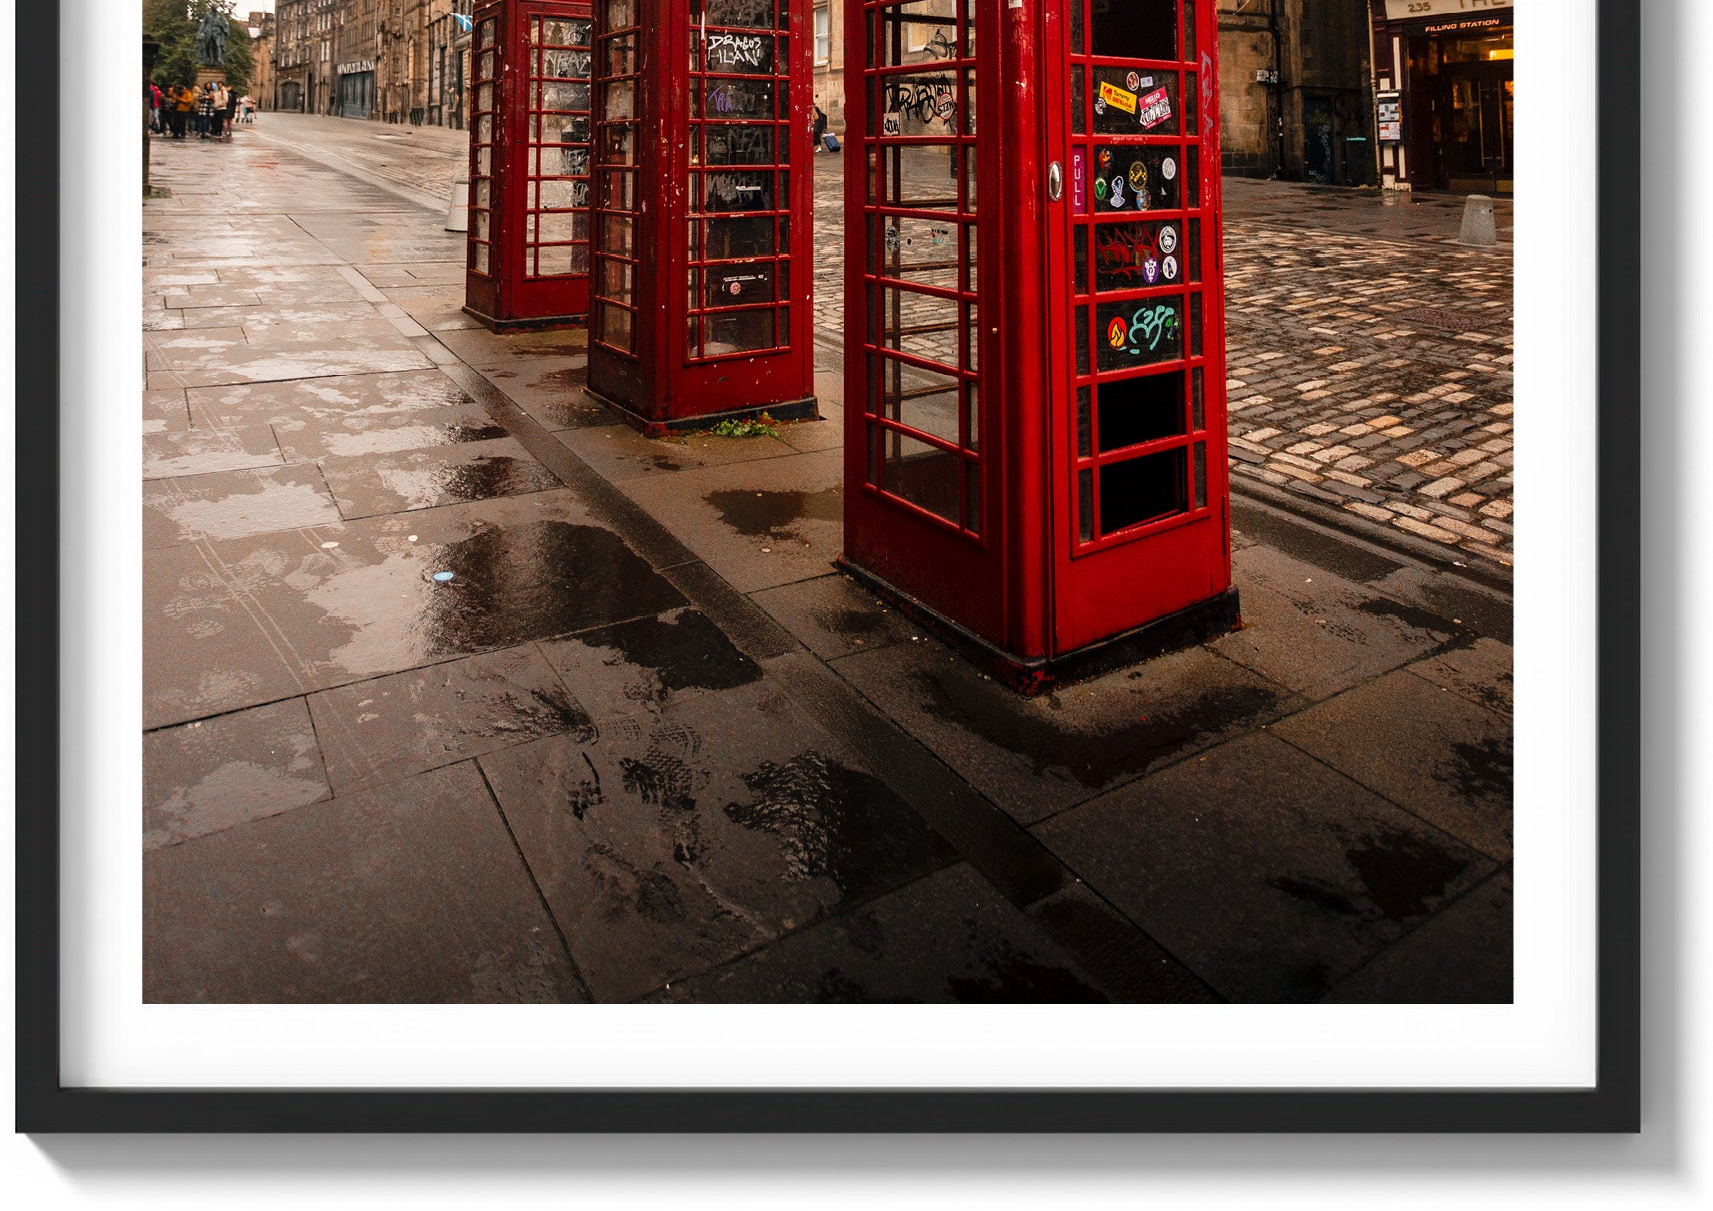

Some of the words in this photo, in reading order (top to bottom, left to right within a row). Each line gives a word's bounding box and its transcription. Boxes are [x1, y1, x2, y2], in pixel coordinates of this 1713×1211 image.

[1408, 2, 1431, 13] 235
[1425, 24, 1457, 32] FILLING
[1460, 19, 1500, 29] STATION
[1073, 154, 1081, 206] PULL
